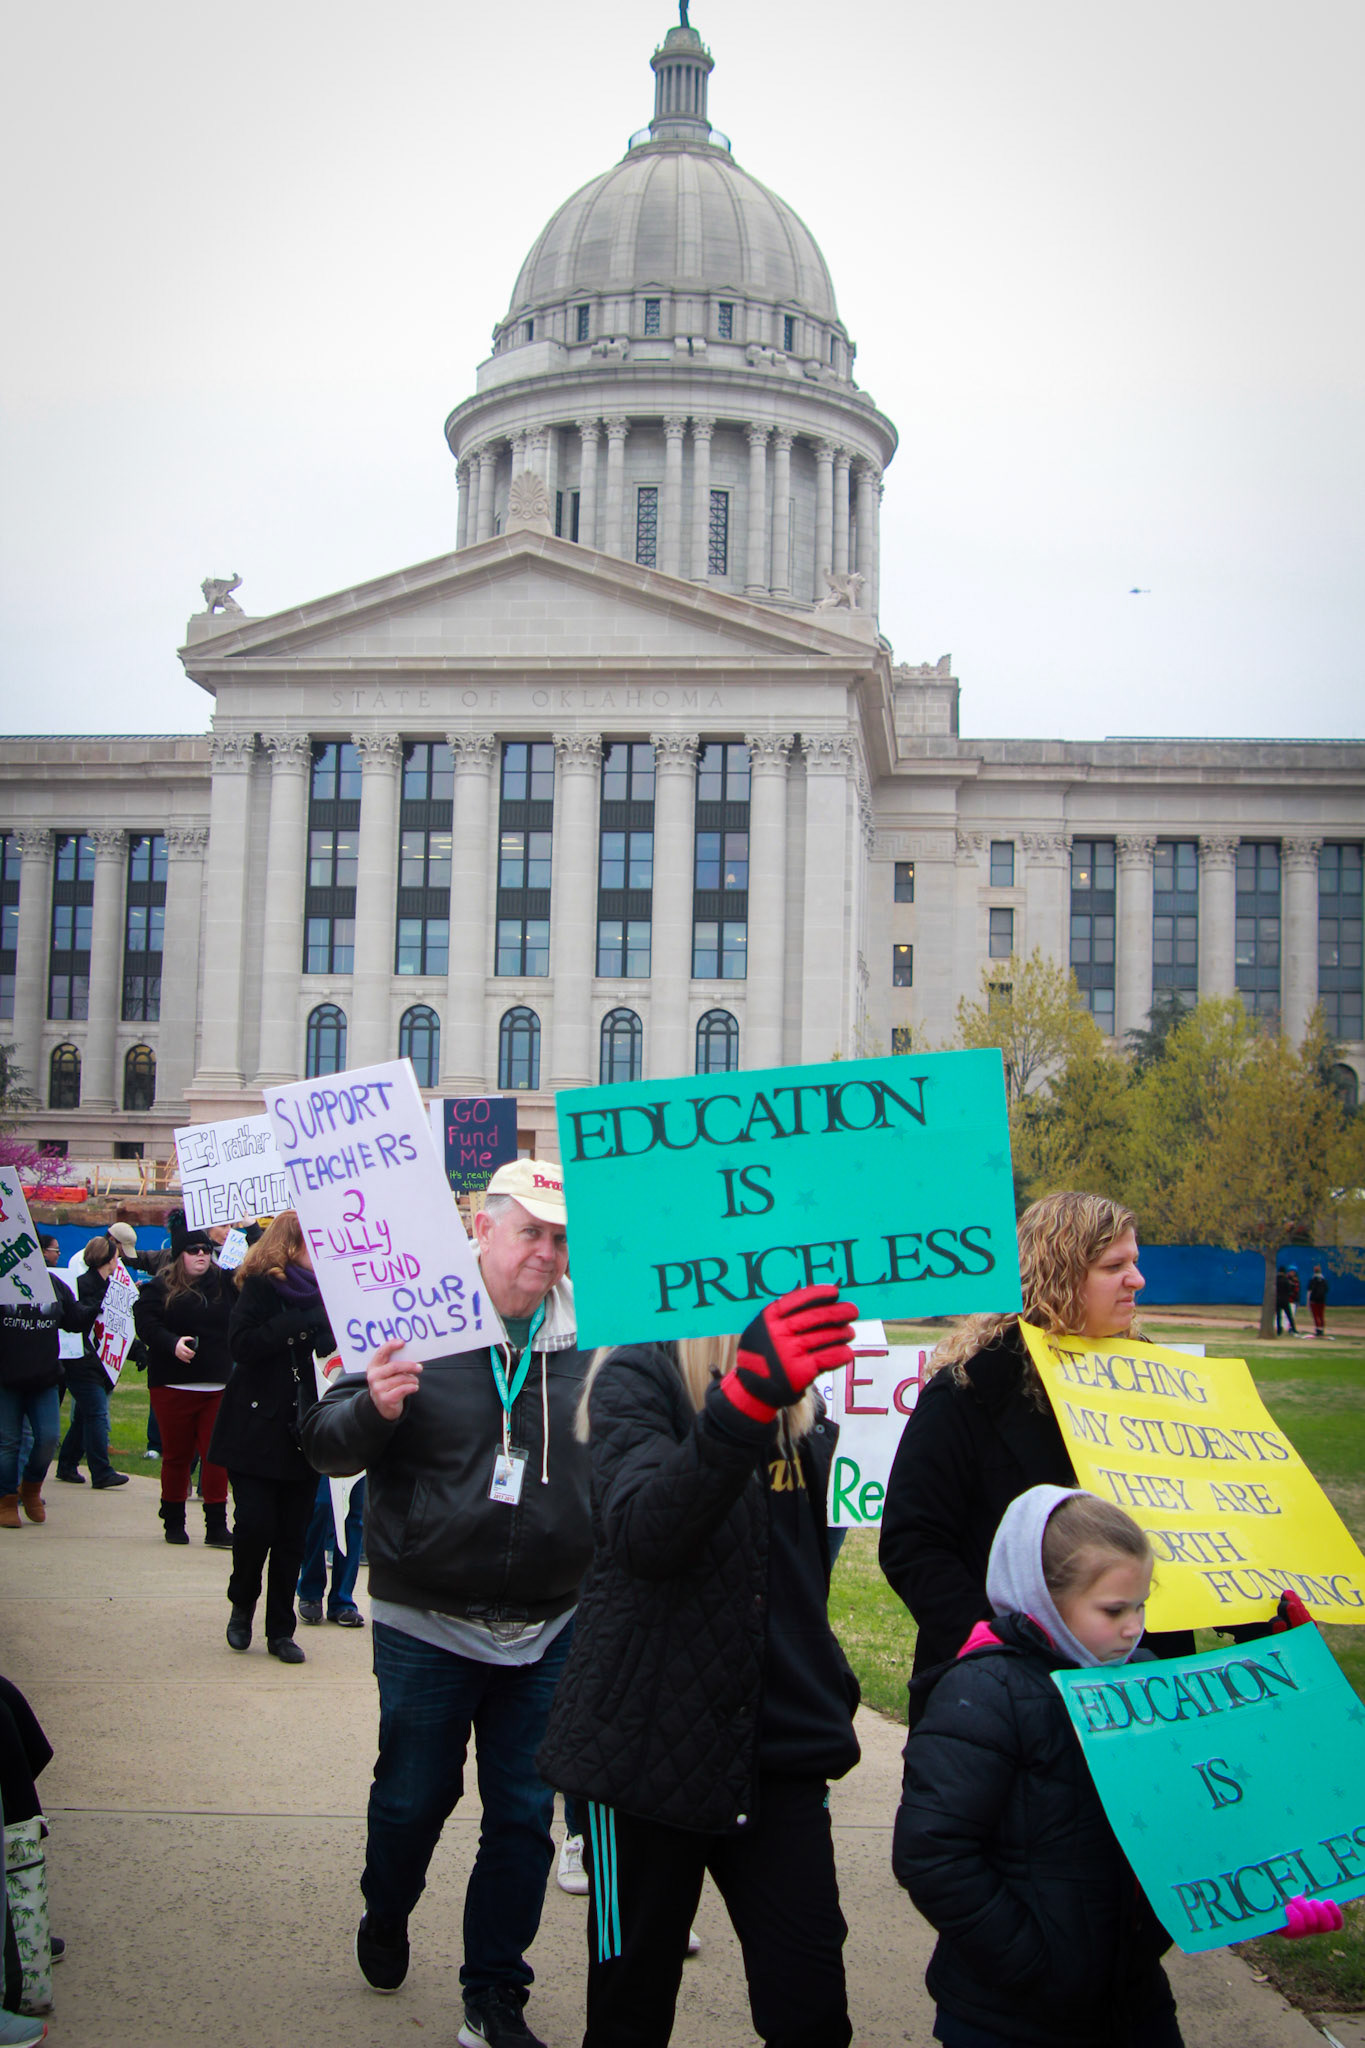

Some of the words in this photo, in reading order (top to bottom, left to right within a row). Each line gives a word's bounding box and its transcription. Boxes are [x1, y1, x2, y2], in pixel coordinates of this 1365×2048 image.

[332, 690, 431, 707] STATE
[461, 690, 502, 707] OF
[531, 690, 724, 707] OKLAHOMA
[275, 1082, 393, 1149] SUPPORT
[453, 1099, 490, 1123] GO
[566, 1076, 929, 1162] EDUCATION
[178, 1130, 220, 1173] I'd
[222, 1125, 271, 1161] rather
[448, 1124, 498, 1147] Fund
[460, 1149, 493, 1168] Me
[285, 1133, 418, 1196] TEACHERS
[343, 1189, 366, 1222] 2
[716, 1165, 775, 1218] IS
[352, 1253, 420, 1287] FUND
[651, 1226, 996, 1312] PRICELESS
[3, 1316, 35, 1330] CENTRAL
[347, 1290, 482, 1352] SCHOOLS!
[1048, 1344, 1208, 1403] TEACHING
[1064, 1402, 1114, 1447] MY
[1120, 1415, 1290, 1461] STUDENTS
[1098, 1468, 1194, 1511] THEY
[1209, 1482, 1282, 1514] ARE
[1143, 1529, 1248, 1563] ORTH
[1200, 1568, 1365, 1607] FUNDING
[1071, 1651, 1299, 1732] EDUCATION
[1192, 1757, 1243, 1810] IS
